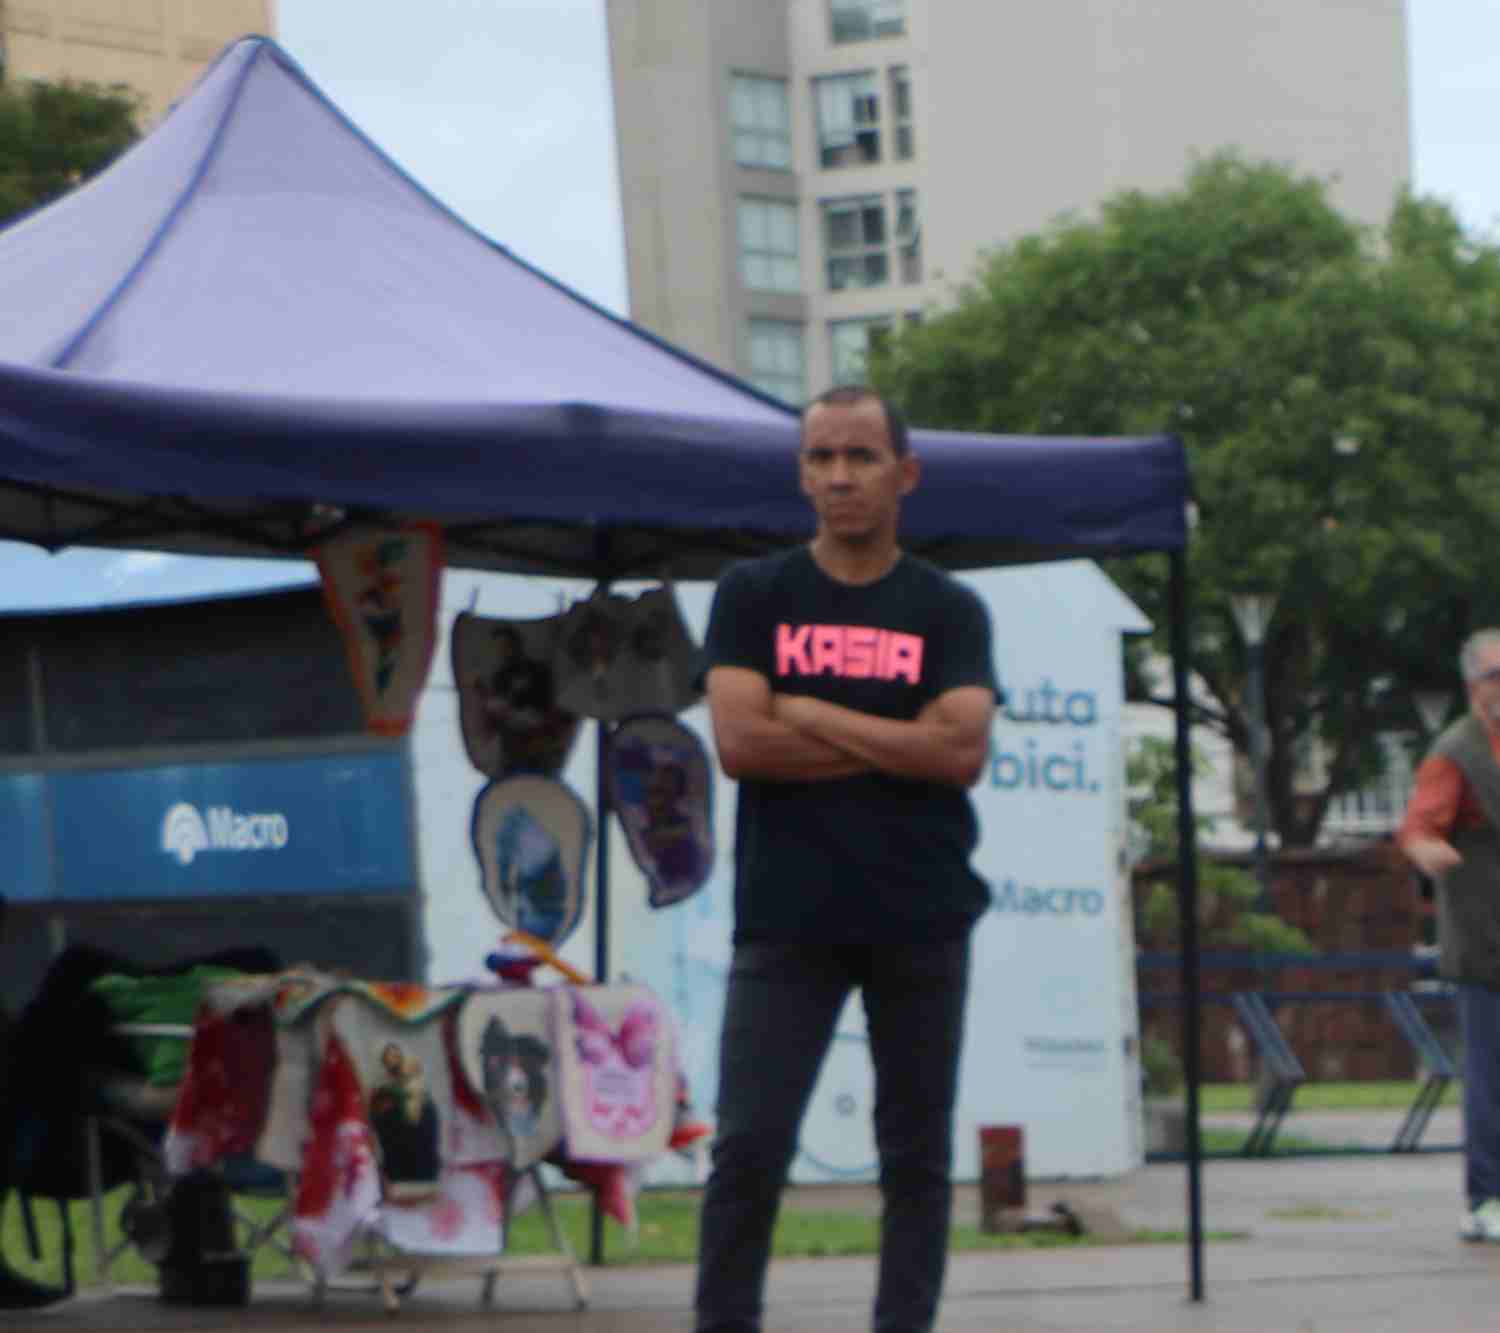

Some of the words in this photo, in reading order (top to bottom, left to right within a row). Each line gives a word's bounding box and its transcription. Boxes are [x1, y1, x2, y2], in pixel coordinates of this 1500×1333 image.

[775, 623, 924, 685] KASIA
[1003, 676, 1097, 725] uta
[206, 804, 288, 850] Macro
